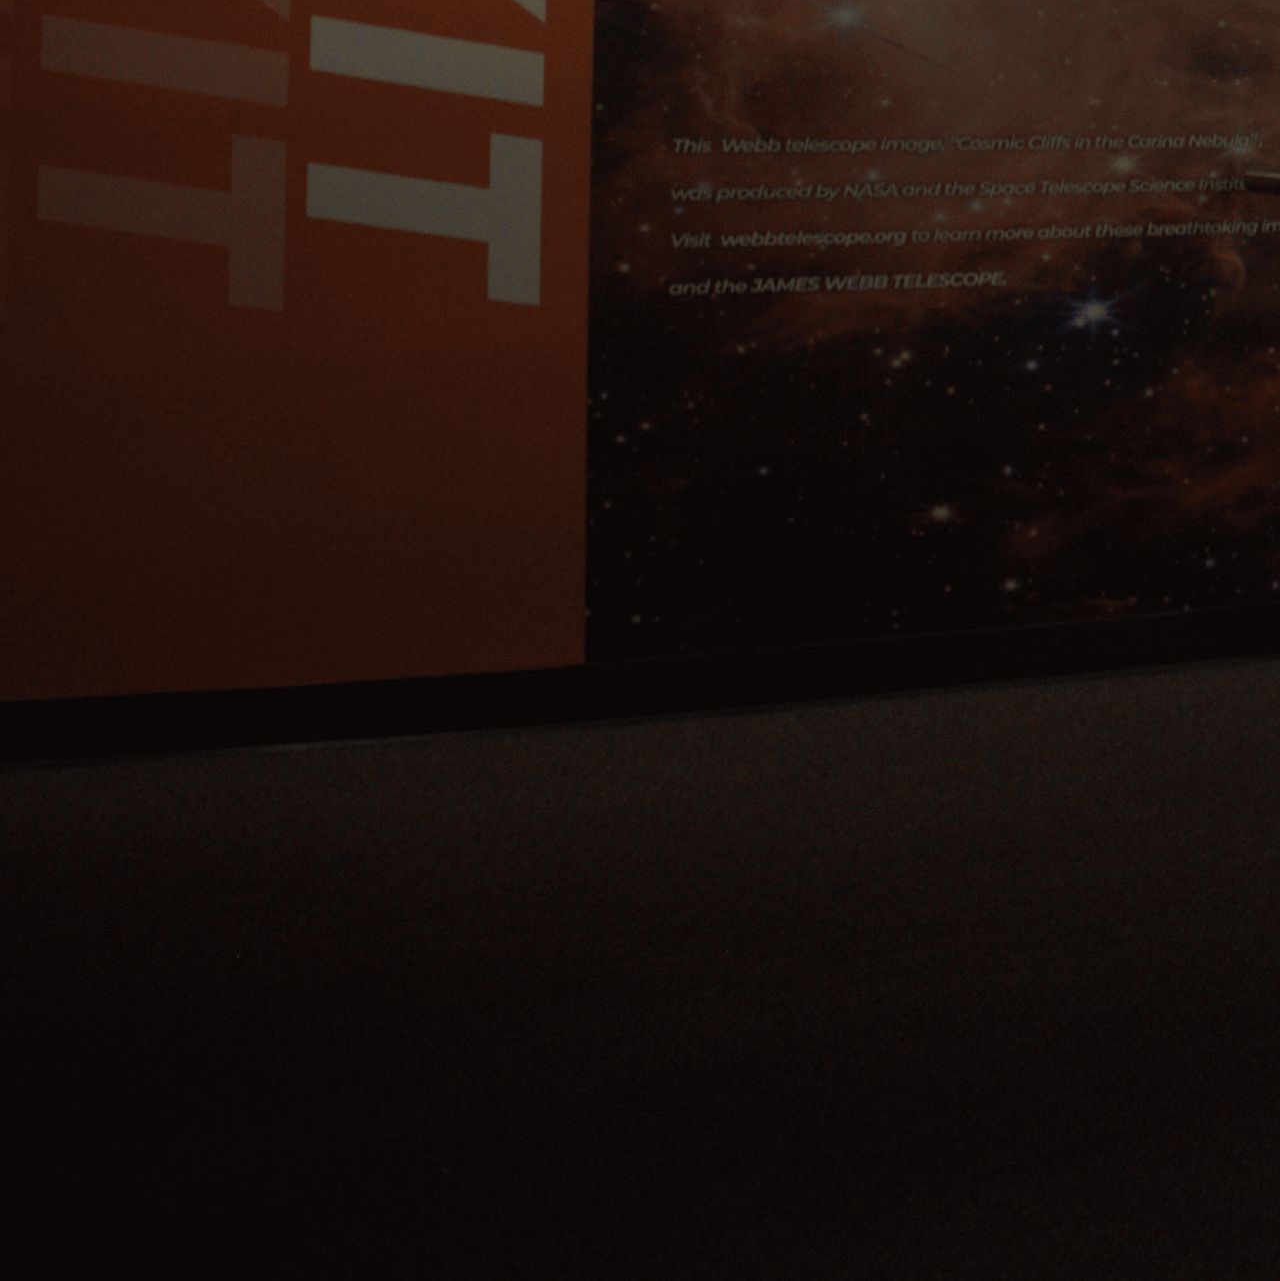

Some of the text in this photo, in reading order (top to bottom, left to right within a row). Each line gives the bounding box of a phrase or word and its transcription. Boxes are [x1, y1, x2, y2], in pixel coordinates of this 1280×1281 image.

[672, 137, 711, 154] This
[722, 137, 781, 153] Webb
[786, 136, 877, 156] telescope
[880, 136, 944, 157] image,
[1028, 134, 1070, 151] Cliffs
[1074, 134, 1090, 150] in
[1094, 134, 1124, 150] the
[1128, 133, 1183, 149] Carina
[671, 186, 712, 202] was
[716, 183, 813, 204] produced
[815, 183, 840, 203] by
[843, 181, 899, 198] NASA
[902, 180, 941, 197] and
[944, 180, 976, 196] the
[980, 180, 1036, 199] Space
[1040, 179, 1126, 197] Telescope
[1129, 177, 1196, 194] Science
[671, 231, 712, 249] Visit
[720, 229, 907, 248] webbtelescope.org
[911, 229, 930, 243] to
[934, 226, 981, 242] learn
[986, 226, 1034, 240] more
[1037, 222, 1092, 240] about
[1095, 221, 1144, 239] these
[1147, 219, 1260, 238] breathtaking
[668, 270, 1008, 297] and the JAMES WEBB TELESCOPE.
